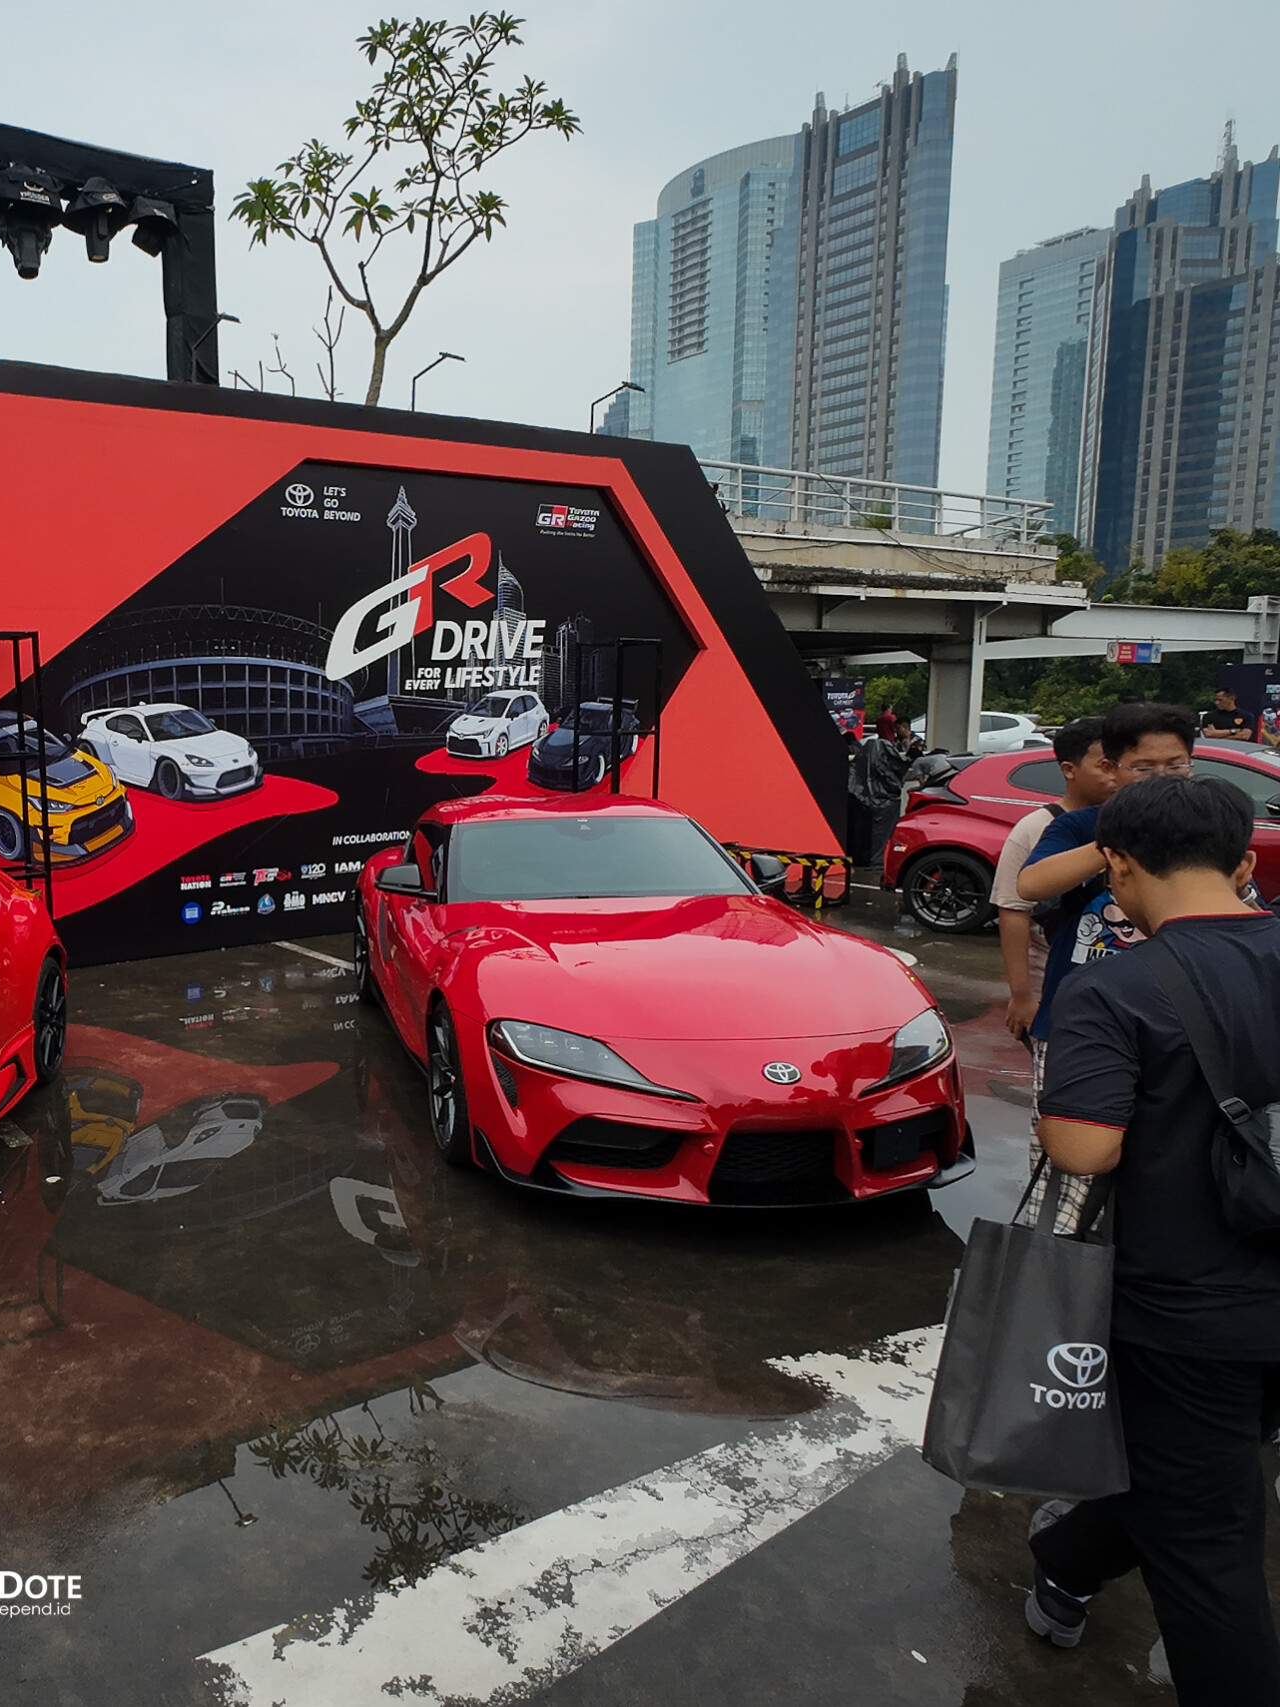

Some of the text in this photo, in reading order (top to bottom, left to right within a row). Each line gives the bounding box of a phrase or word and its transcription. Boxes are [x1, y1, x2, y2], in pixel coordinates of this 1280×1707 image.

[323, 486, 347, 497] LET'S
[323, 498, 339, 508] GO
[280, 507, 319, 518] TOYOTA
[323, 510, 361, 521] BEYOND
[569, 507, 600, 516] TOYOTA
[538, 513, 565, 526] GR
[567, 514, 597, 522] GAZOO
[326, 532, 495, 681] GR
[431, 620, 546, 660] DRIVE
[417, 667, 441, 678] FOR
[444, 666, 541, 688] LIFESTYLE
[405, 679, 441, 690] EVERY
[332, 830, 411, 846] IN COLLABORATION
[180, 875, 210, 883] TOYOTA
[180, 881, 212, 890] NATION
[312, 890, 347, 905] MNCV
[1029, 1383, 1106, 1409] TOYOTA
